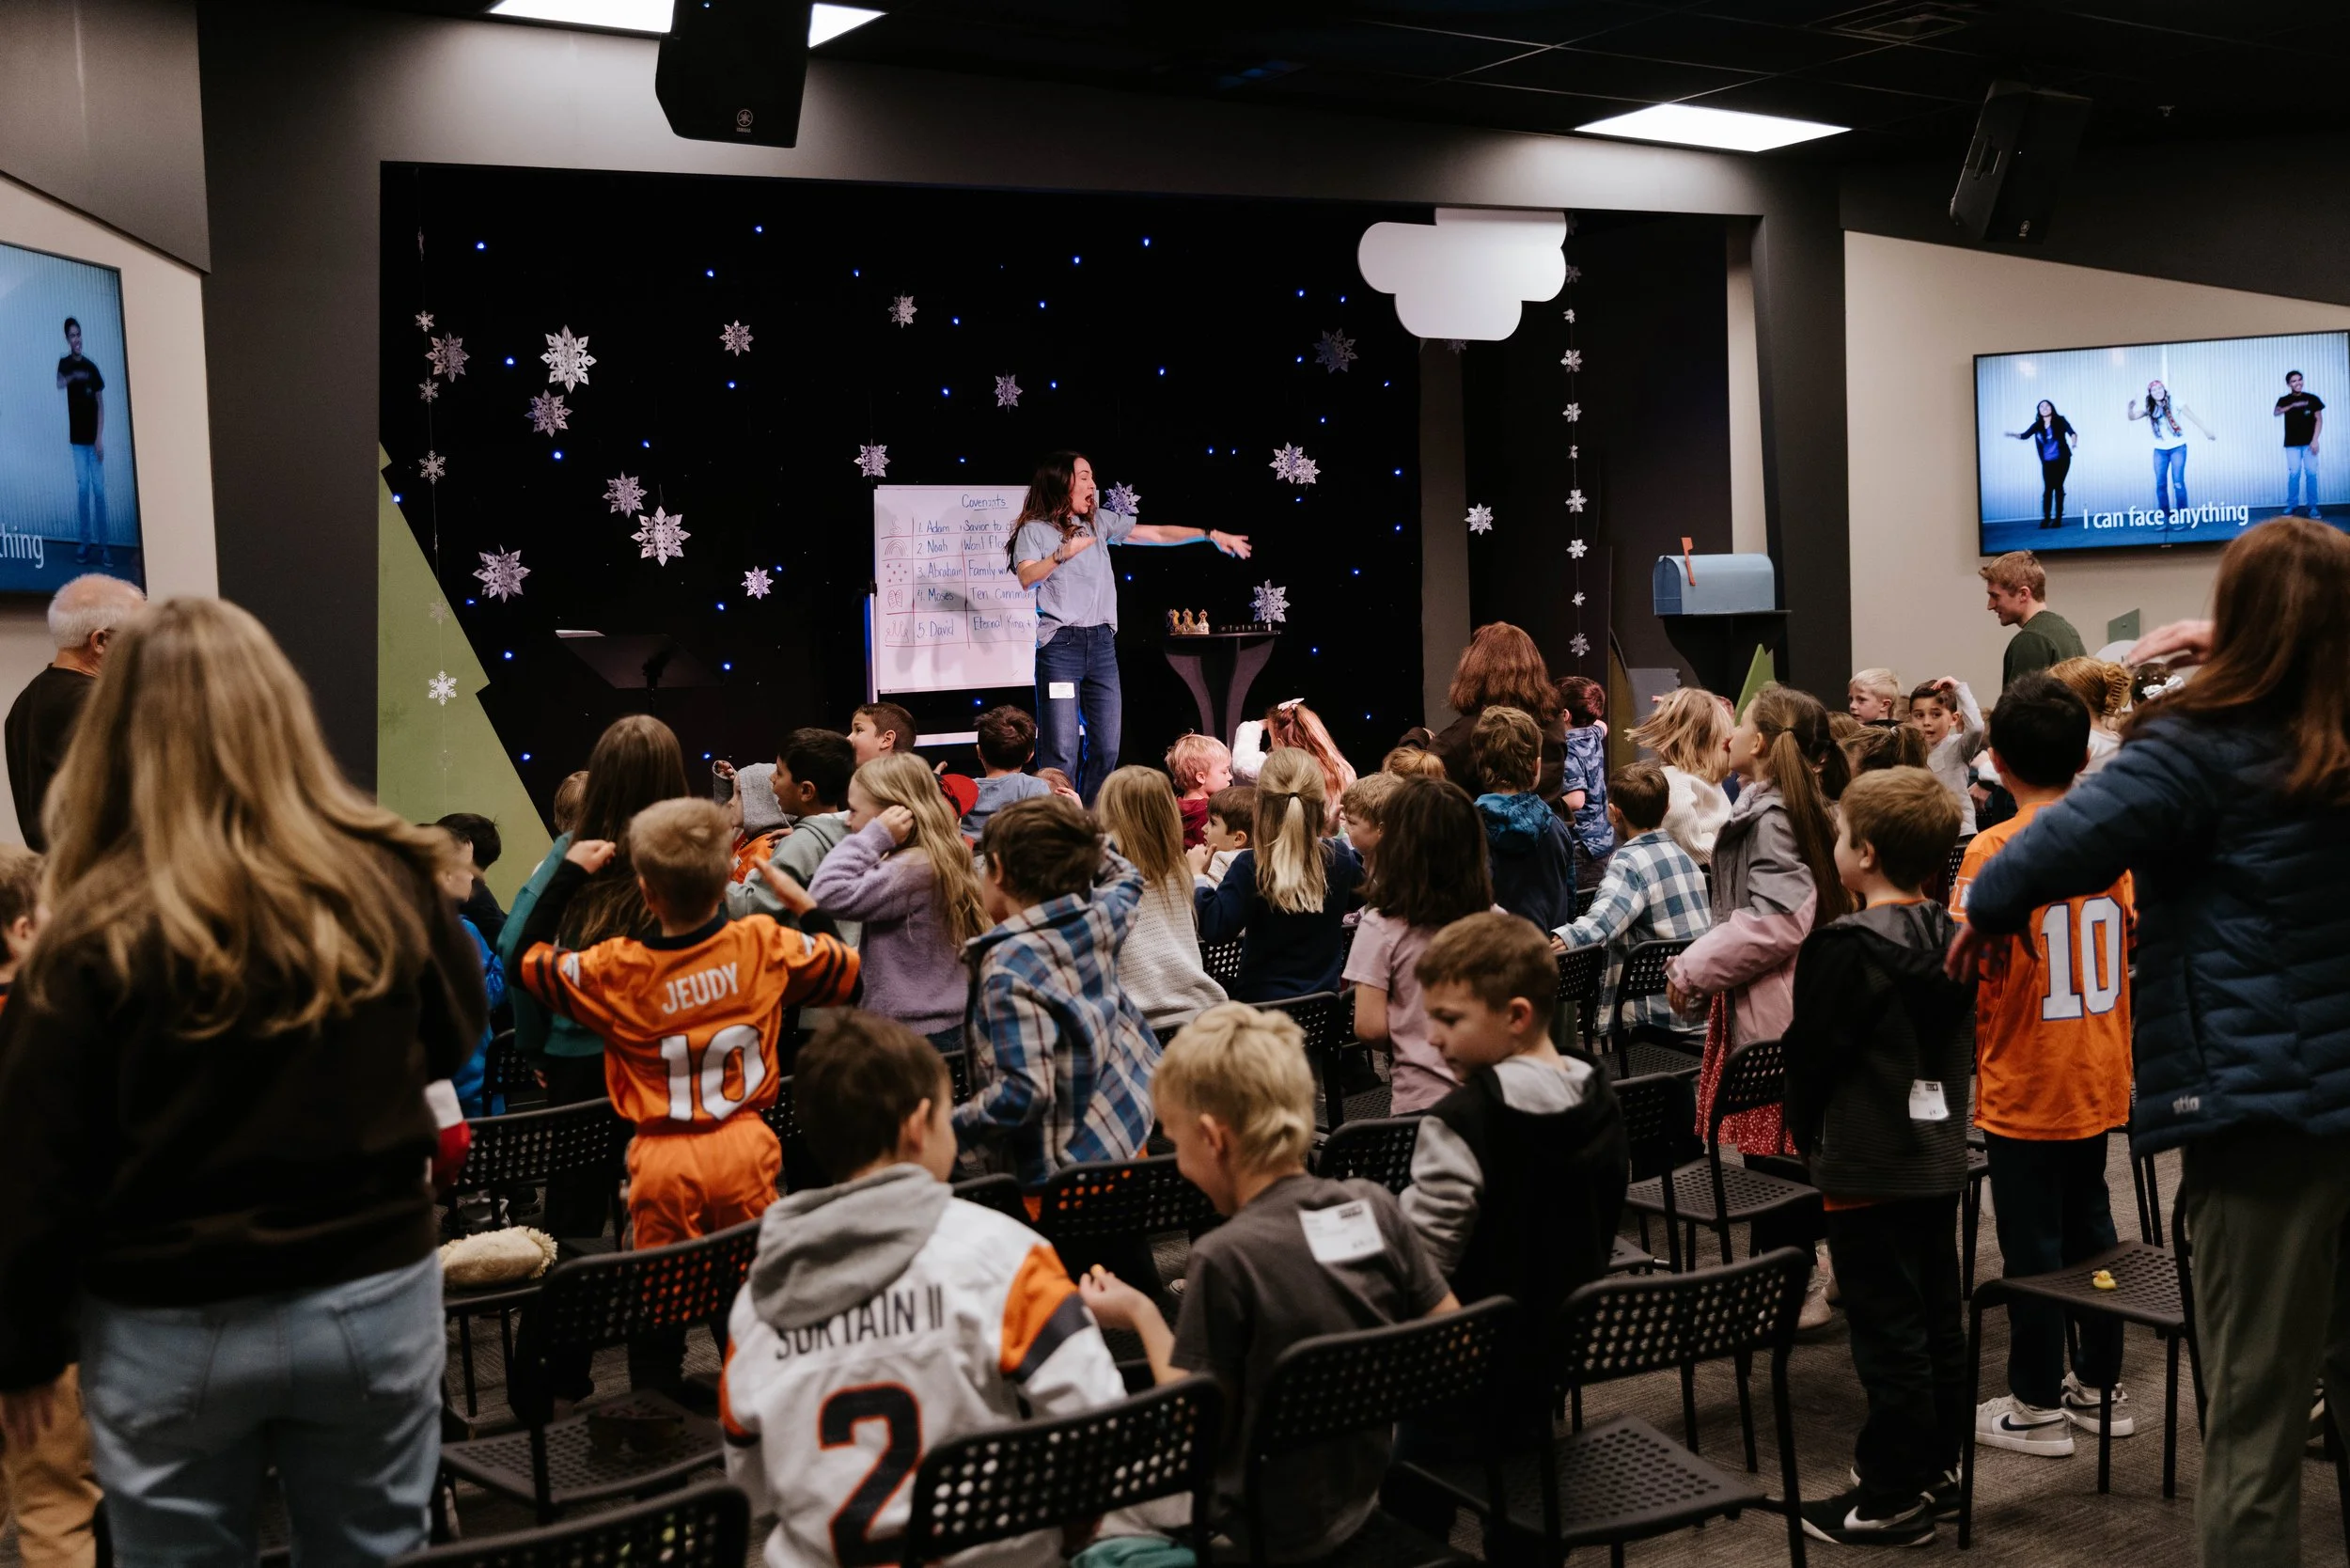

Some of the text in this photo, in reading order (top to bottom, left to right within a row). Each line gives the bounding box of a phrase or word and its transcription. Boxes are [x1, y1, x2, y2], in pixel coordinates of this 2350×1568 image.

[2083, 501, 2249, 529] I can face anything
[926, 519, 950, 533] Adam
[964, 519, 990, 532] Savior
[993, 519, 1002, 531] to
[0, 523, 44, 570] hing
[927, 538, 948, 554] Noah
[928, 561, 964, 579] Abraham
[968, 559, 995, 580] Family
[928, 588, 954, 602] Moses
[970, 587, 989, 602] Ten
[930, 619, 954, 637] David
[973, 614, 1003, 631] Eternal
[1006, 614, 1026, 634] King
[2041, 894, 2123, 1022] 10
[661, 962, 740, 1015] JEUDY
[660, 1022, 767, 1122] 10
[819, 1381, 925, 1567] 2
